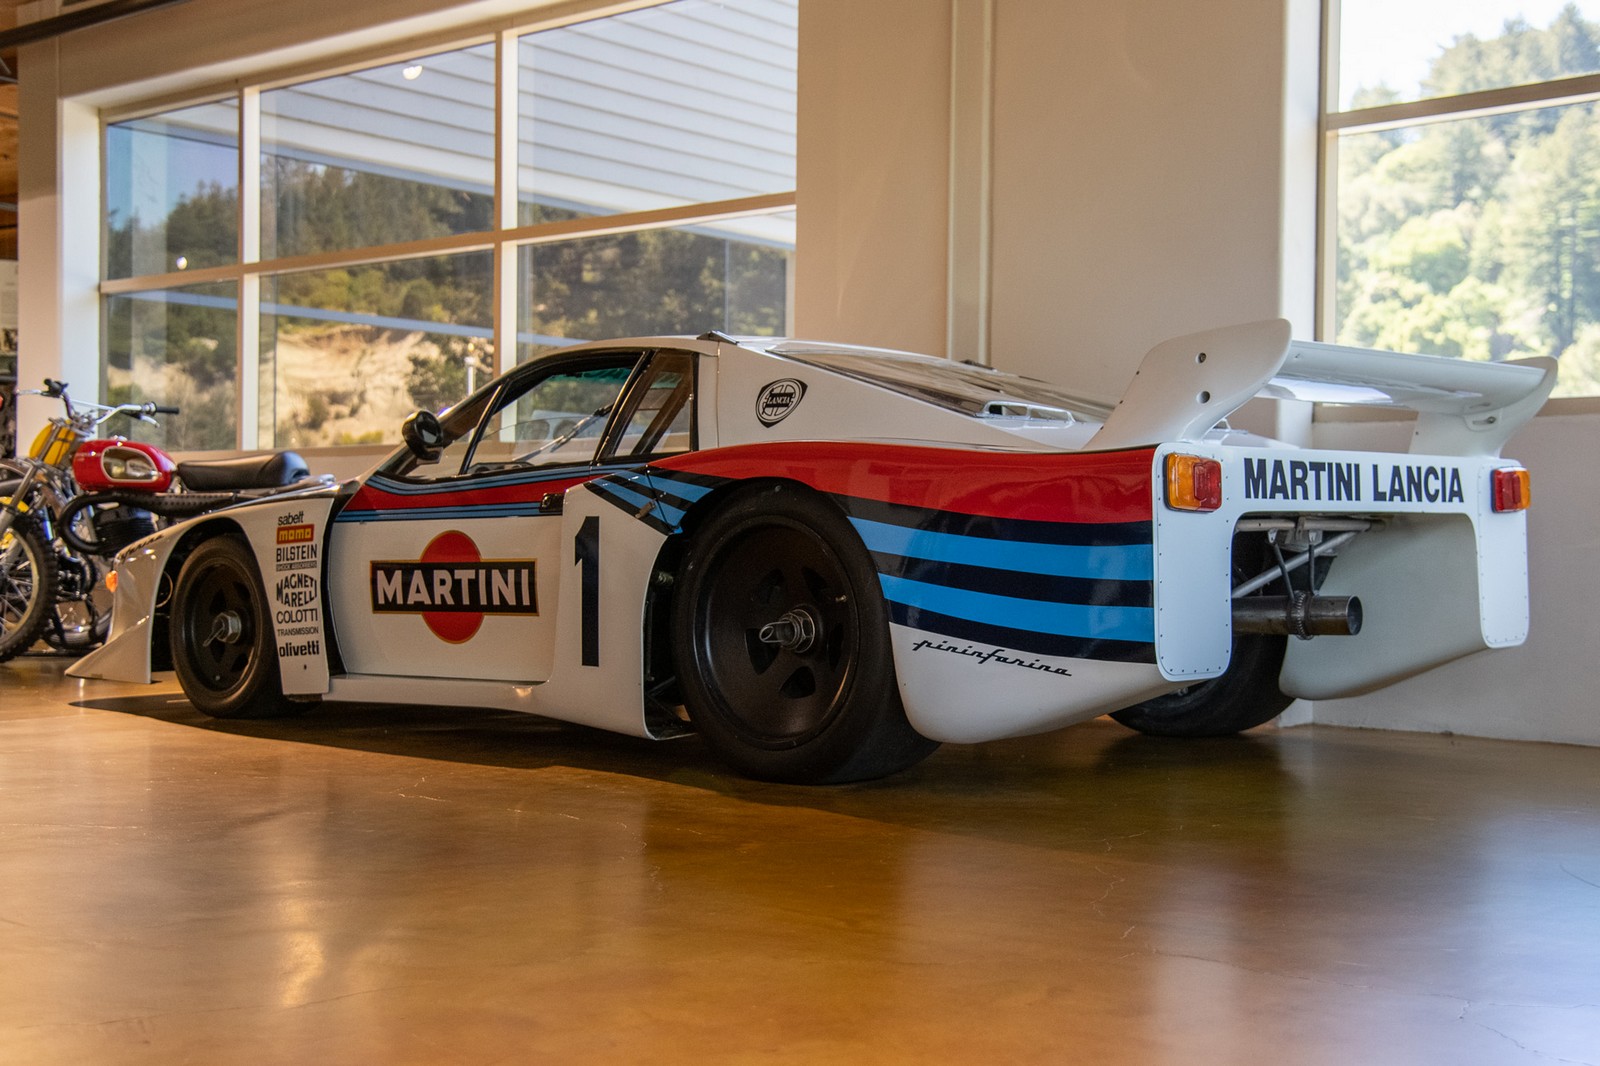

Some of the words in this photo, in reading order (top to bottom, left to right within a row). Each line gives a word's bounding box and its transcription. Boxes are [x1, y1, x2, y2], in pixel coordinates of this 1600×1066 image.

[767, 396, 789, 404] LANCIA
[1243, 457, 1361, 501] MARTINI
[1372, 464, 1464, 503] LANCIA
[278, 510, 304, 526] sabelt
[279, 528, 312, 542] momo
[276, 544, 318, 562] BILSTEIN
[276, 573, 317, 597] MAGNETI
[376, 568, 531, 606] MARTINI
[574, 516, 600, 667] 1
[276, 585, 317, 608] MARELLI
[276, 608, 318, 624] COLOTTI
[277, 626, 319, 637] TRANSMISSION
[279, 640, 319, 657] olivetti
[911, 639, 1072, 677] pininfarina
